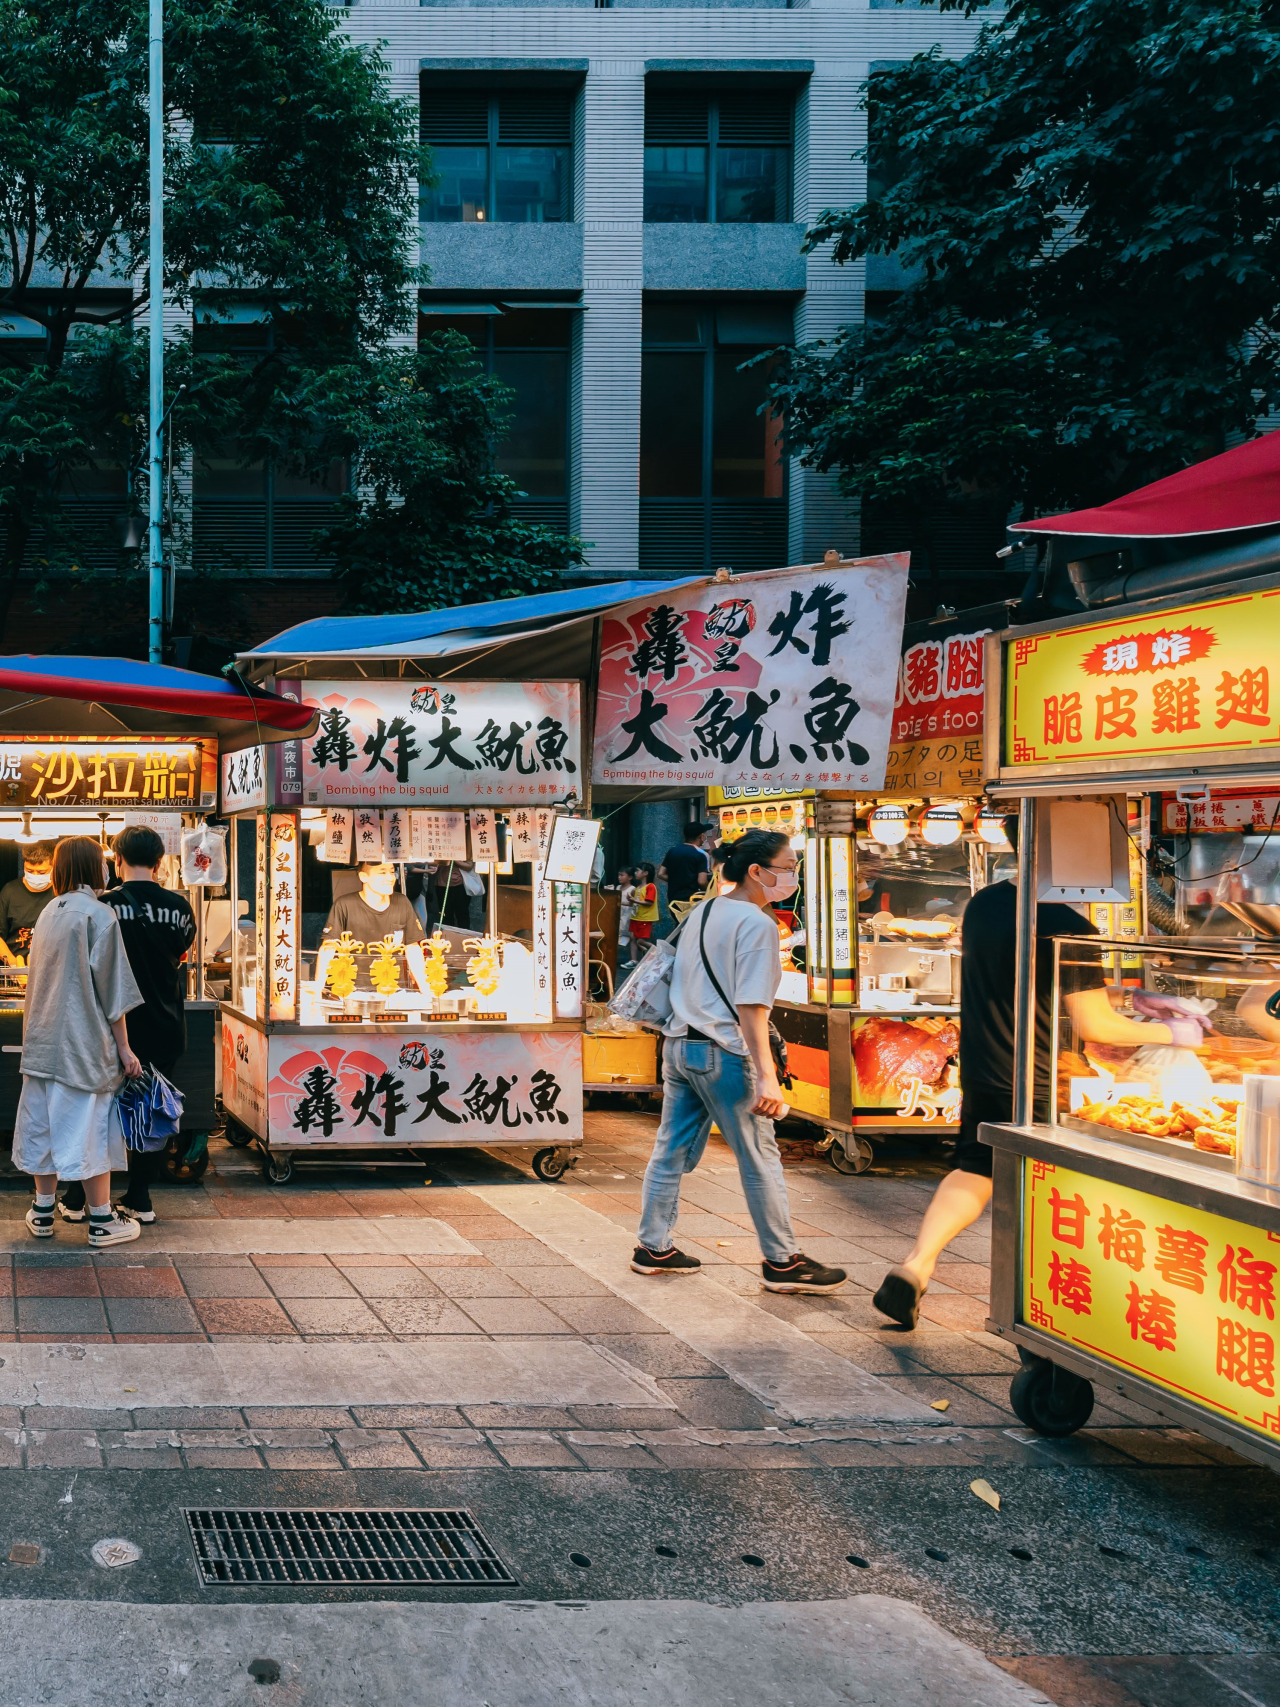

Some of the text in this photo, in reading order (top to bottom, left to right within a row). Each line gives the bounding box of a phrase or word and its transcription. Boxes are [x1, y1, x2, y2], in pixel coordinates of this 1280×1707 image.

[1102, 633, 1191, 671] 現炸
[895, 637, 985, 708] 豬腳
[409, 686, 457, 715] 魷皇
[1043, 666, 1271, 746] 脆皮雞翅
[610, 676, 870, 770] 大魷魚
[897, 714, 937, 740] pig's
[310, 707, 576, 783] 轟炸大魷魚
[282, 783, 301, 792] 079
[326, 784, 449, 797] Bombing the big squid
[602, 769, 714, 781] Bombing the big squid
[38, 794, 77, 806] No.77
[79, 795, 109, 806] salad
[112, 795, 137, 806] boat
[150, 815, 158, 823] 70
[161, 815, 169, 824] 元
[331, 812, 346, 845] 椒鹽
[360, 812, 374, 843] 孜然
[389, 812, 402, 848] 美乃滋
[475, 813, 488, 844] 海苔
[515, 812, 531, 843] 辣味
[399, 1041, 446, 1071] 魷皇
[293, 1066, 569, 1137] 轟炸大魷魚
[1047, 1186, 1279, 1320] 甘梅薯條
[1047, 1251, 1275, 1398] 棒棒腿
